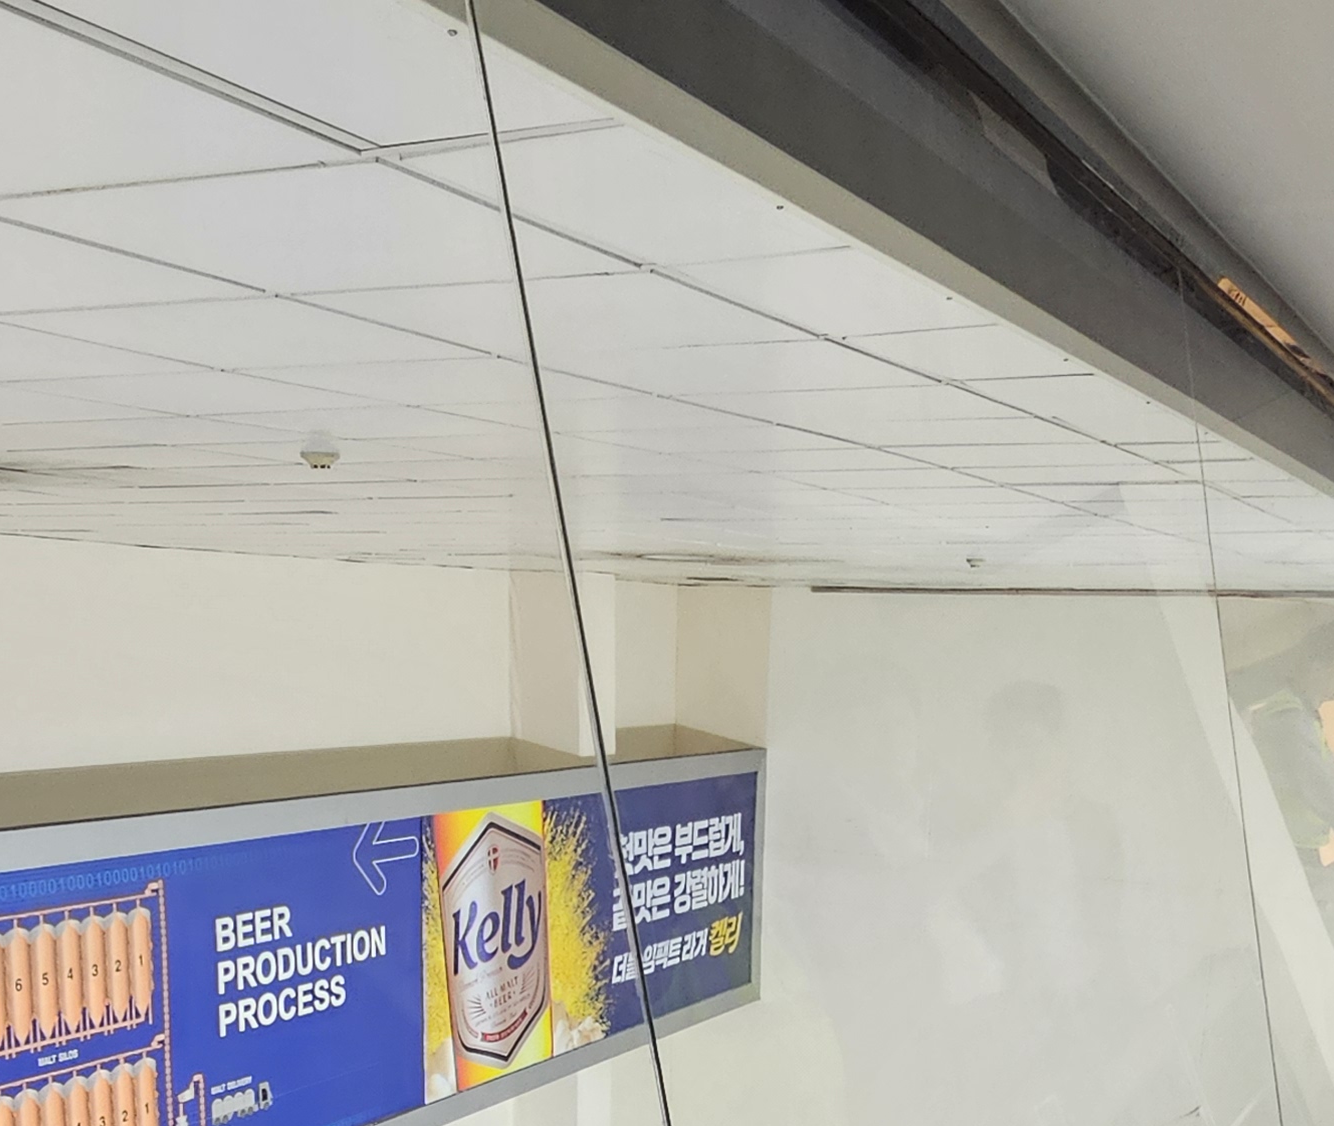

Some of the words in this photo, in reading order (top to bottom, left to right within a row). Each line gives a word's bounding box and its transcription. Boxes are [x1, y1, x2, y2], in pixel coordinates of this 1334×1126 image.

[674, 812, 745, 865] 부드럽게,
[673, 859, 746, 915] 강렬하게!
[215, 906, 293, 952] BEER
[452, 878, 542, 977] Kelly
[708, 911, 744, 957] 켈리
[217, 926, 387, 995] PRODUCTION
[218, 974, 346, 1037] PROCESS
